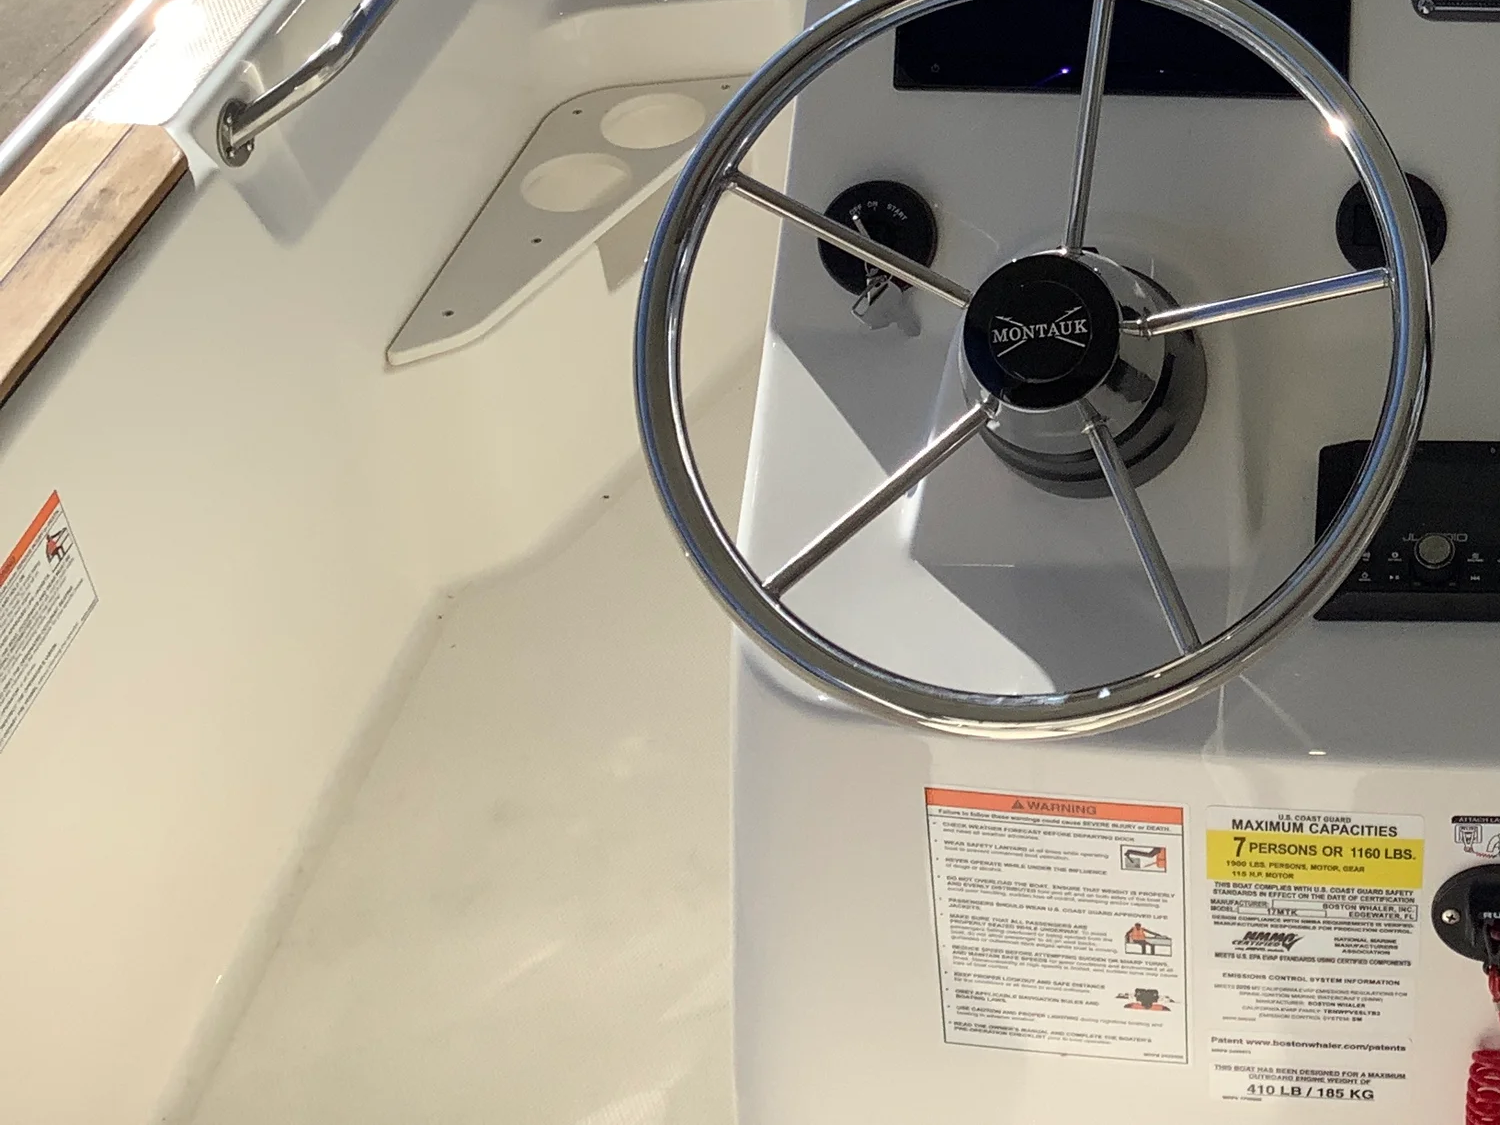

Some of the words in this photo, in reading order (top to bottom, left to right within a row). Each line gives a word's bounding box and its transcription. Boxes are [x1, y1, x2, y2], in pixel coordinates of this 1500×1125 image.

[992, 319, 1088, 344] MONTAUK
[1027, 801, 1097, 815] WARNING
[1232, 819, 1304, 833] MAXIMUM
[1309, 823, 1398, 837] CAPACITIES
[1233, 837, 1246, 857] 7
[1249, 842, 1317, 856] PERSONS
[1322, 846, 1343, 857] OR
[1351, 848, 1380, 859] 1160
[1385, 849, 1416, 860] LBS.
[1254, 883, 1292, 891] COMPLIES
[1213, 889, 1257, 897] STANDARDS
[1269, 891, 1297, 899] EFFECT
[1360, 895, 1415, 903] CERTIFICATION
[1267, 908, 1298, 916] 17MTK
[1211, 1036, 1243, 1045] Patent
[1247, 1084, 1275, 1095] 410
[1280, 1086, 1301, 1096] LB
[1306, 1086, 1313, 1096] /
[1317, 1088, 1344, 1098] 185
[1350, 1089, 1374, 1100] KG
